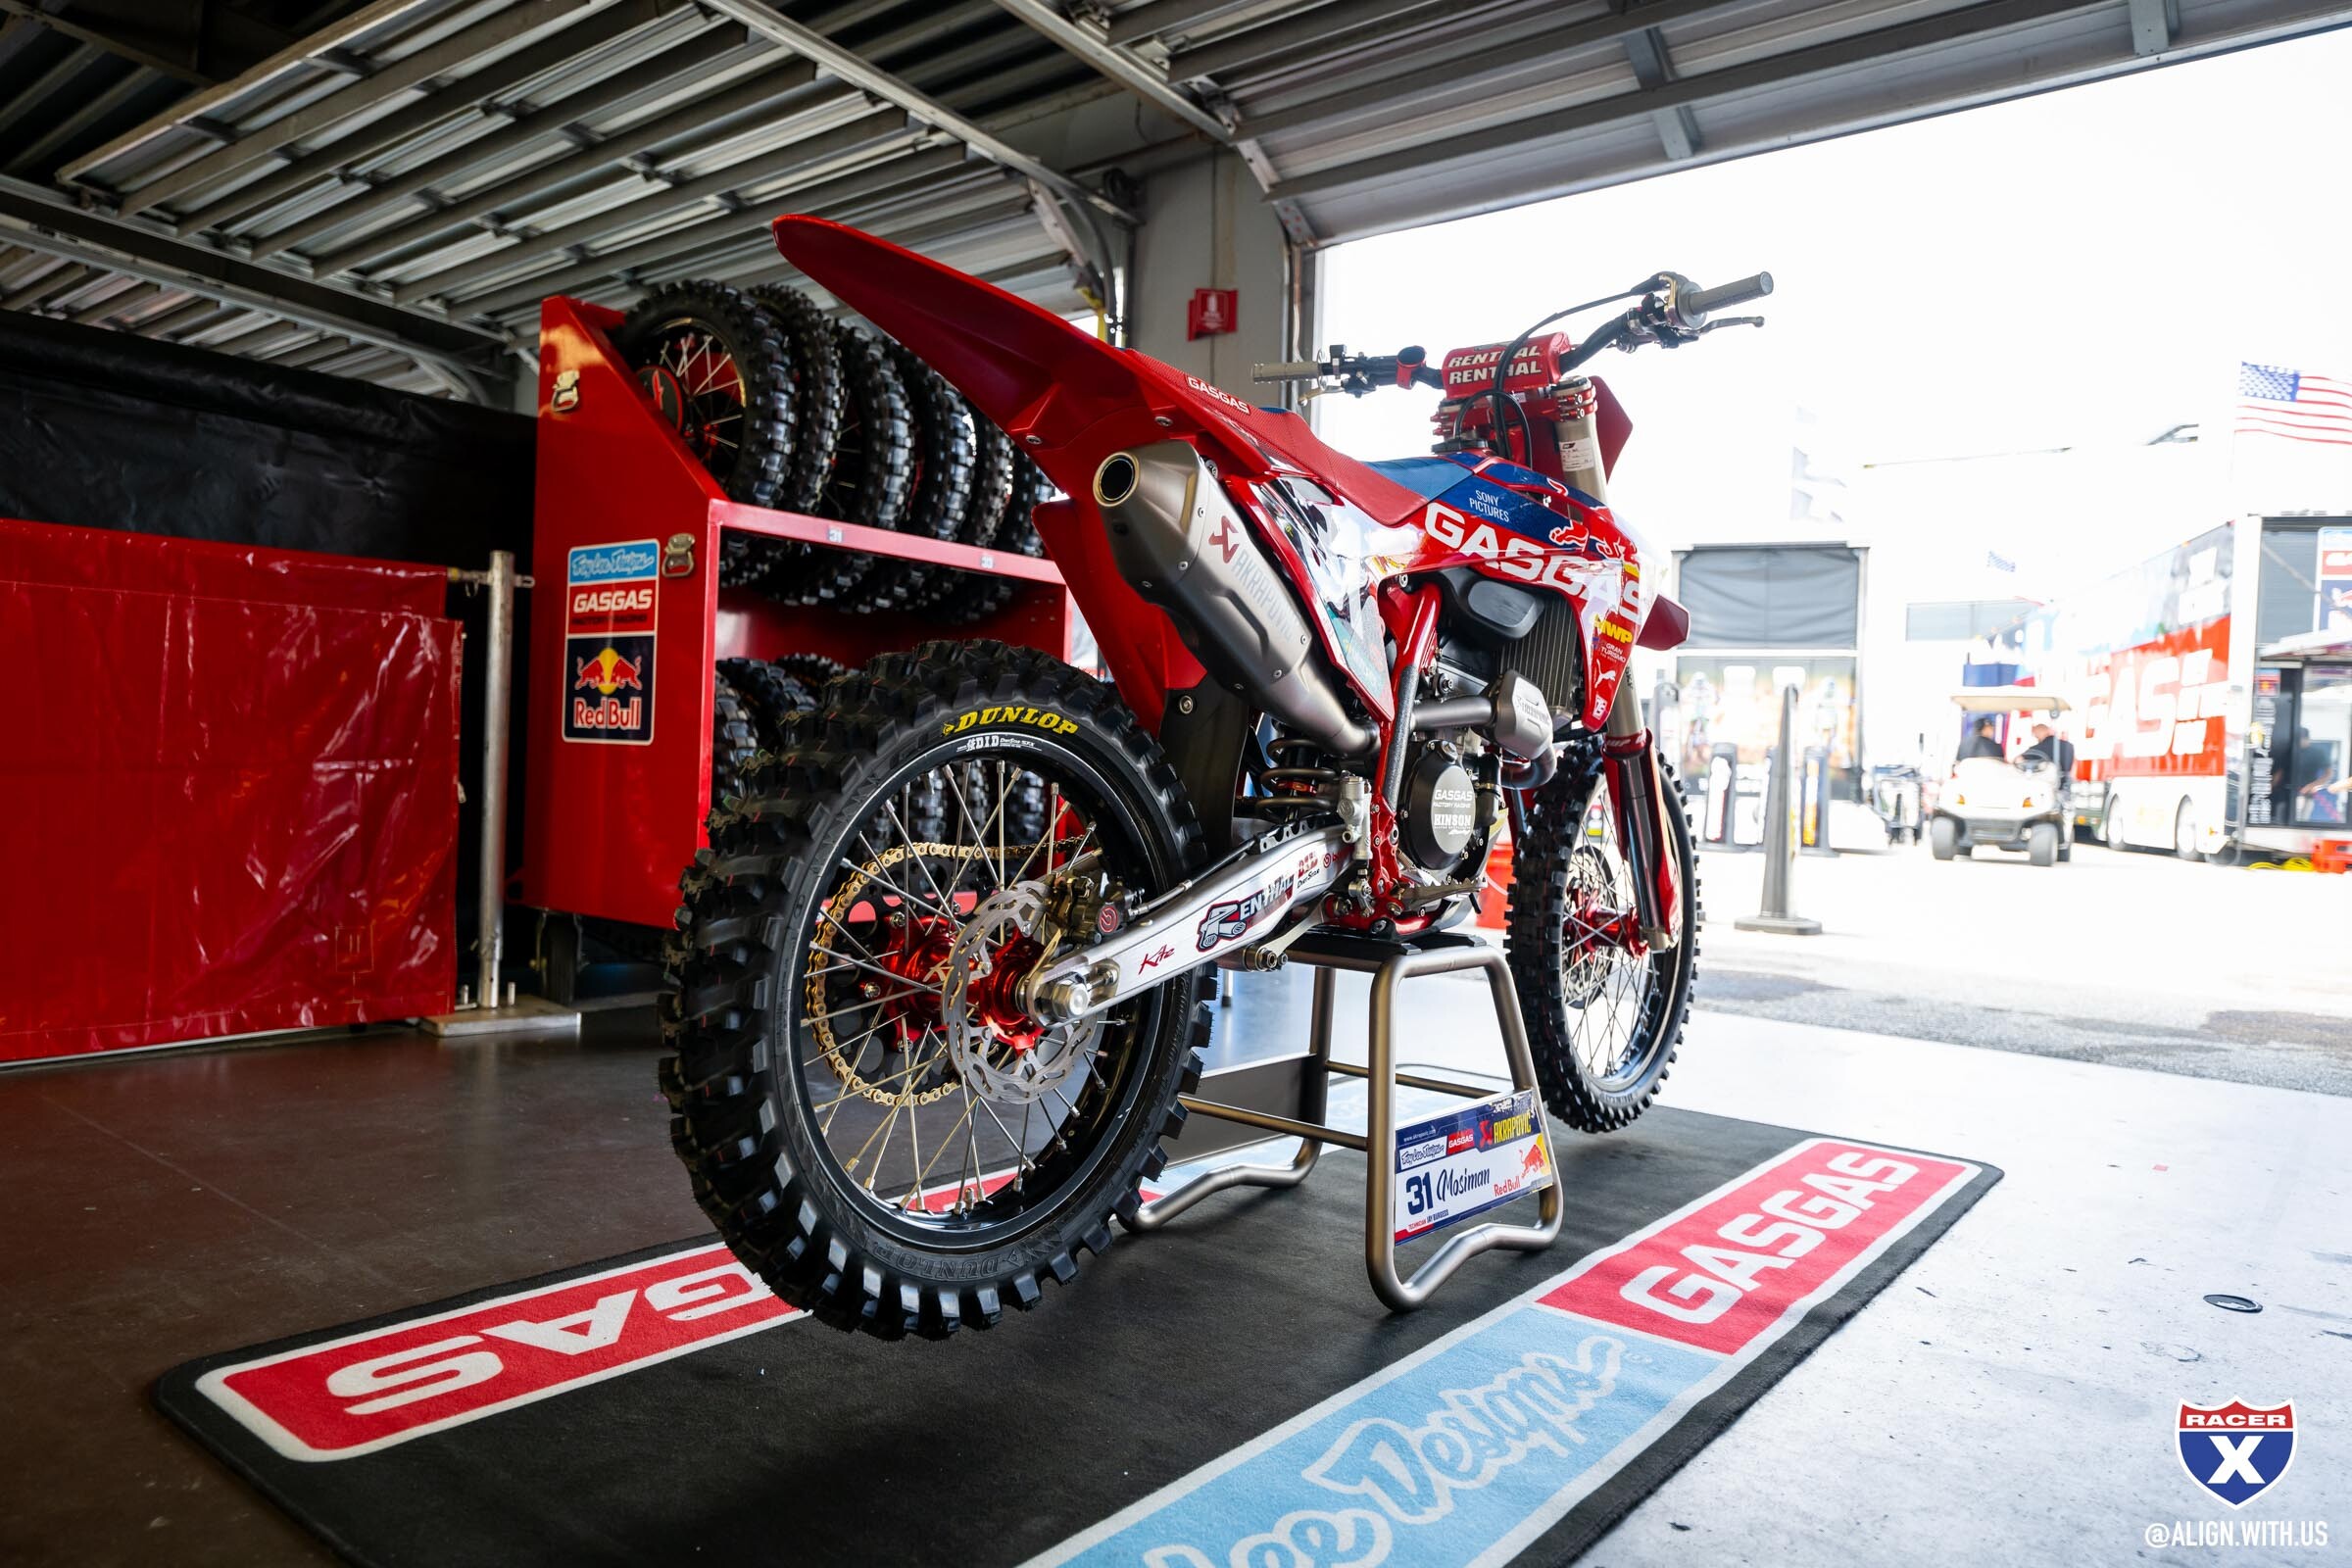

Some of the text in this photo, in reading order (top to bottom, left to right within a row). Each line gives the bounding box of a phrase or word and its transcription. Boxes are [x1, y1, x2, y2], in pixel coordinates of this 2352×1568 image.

[1448, 346, 1541, 368] RENTAL
[1448, 360, 1542, 385] RENTAL
[1187, 376, 1250, 415] GASGAS
[1469, 497, 1510, 522] PICTURES
[1475, 489, 1498, 507] SONY
[1424, 501, 1643, 625] GASGAS
[572, 589, 653, 613] GASGAS
[1600, 647, 1627, 663] TURISMO
[1605, 643, 1624, 656] GRAN
[573, 697, 642, 730] Red Bull
[954, 706, 1079, 735] DUNLOP
[1434, 789, 1473, 802] GASGAS
[1434, 813, 1472, 827] HINSON
[1138, 945, 1175, 975] Kite
[1448, 1133, 1474, 1149] GASGAS
[1405, 1167, 1521, 1216] 31 Mosiman Red Bull
[1620, 1152, 1920, 1324] GASGAS
[1301, 1336, 1626, 1526] Designs
